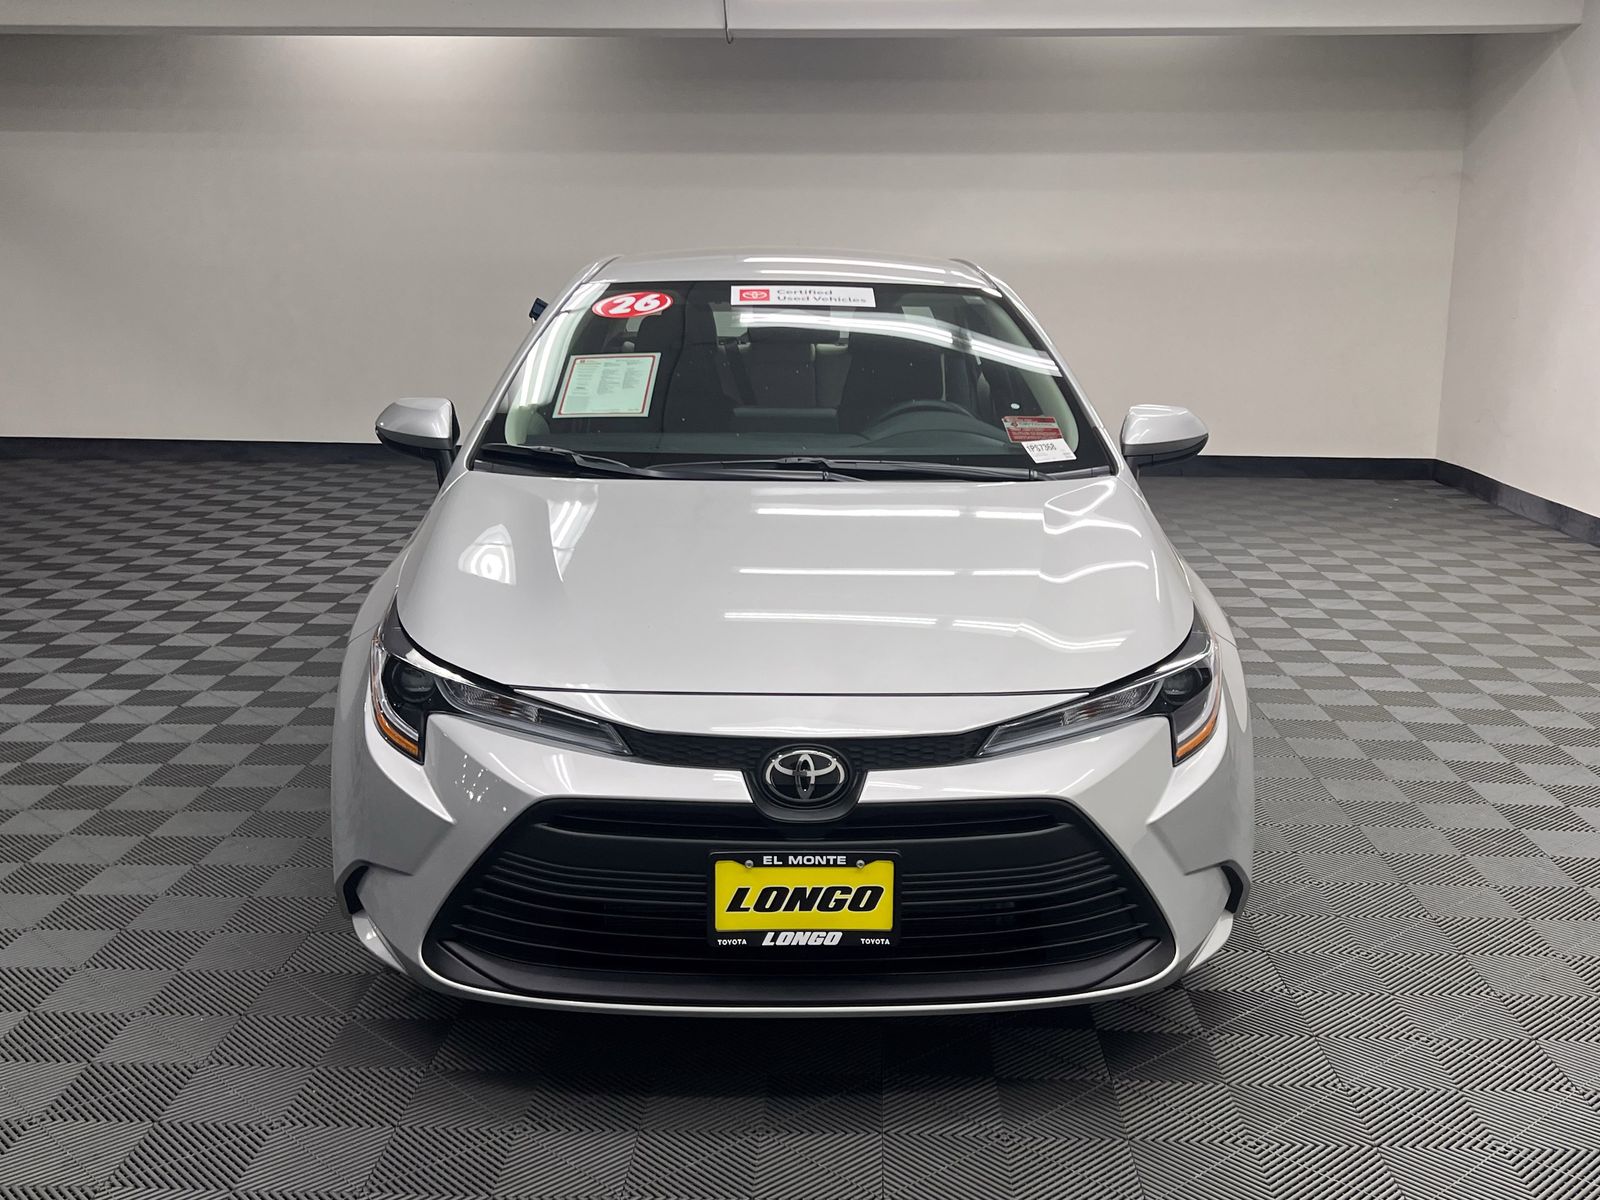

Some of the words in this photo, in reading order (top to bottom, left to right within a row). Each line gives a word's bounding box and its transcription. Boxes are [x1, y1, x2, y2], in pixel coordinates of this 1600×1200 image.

[608, 293, 661, 314] 26
[813, 295, 867, 303] Vehicles
[762, 855, 783, 865] EL
[788, 855, 847, 865] MONTE
[725, 885, 885, 913] LONGO
[717, 938, 747, 946] TOYOTA
[761, 931, 843, 946] LONGO
[860, 937, 890, 945] TOYOTA
